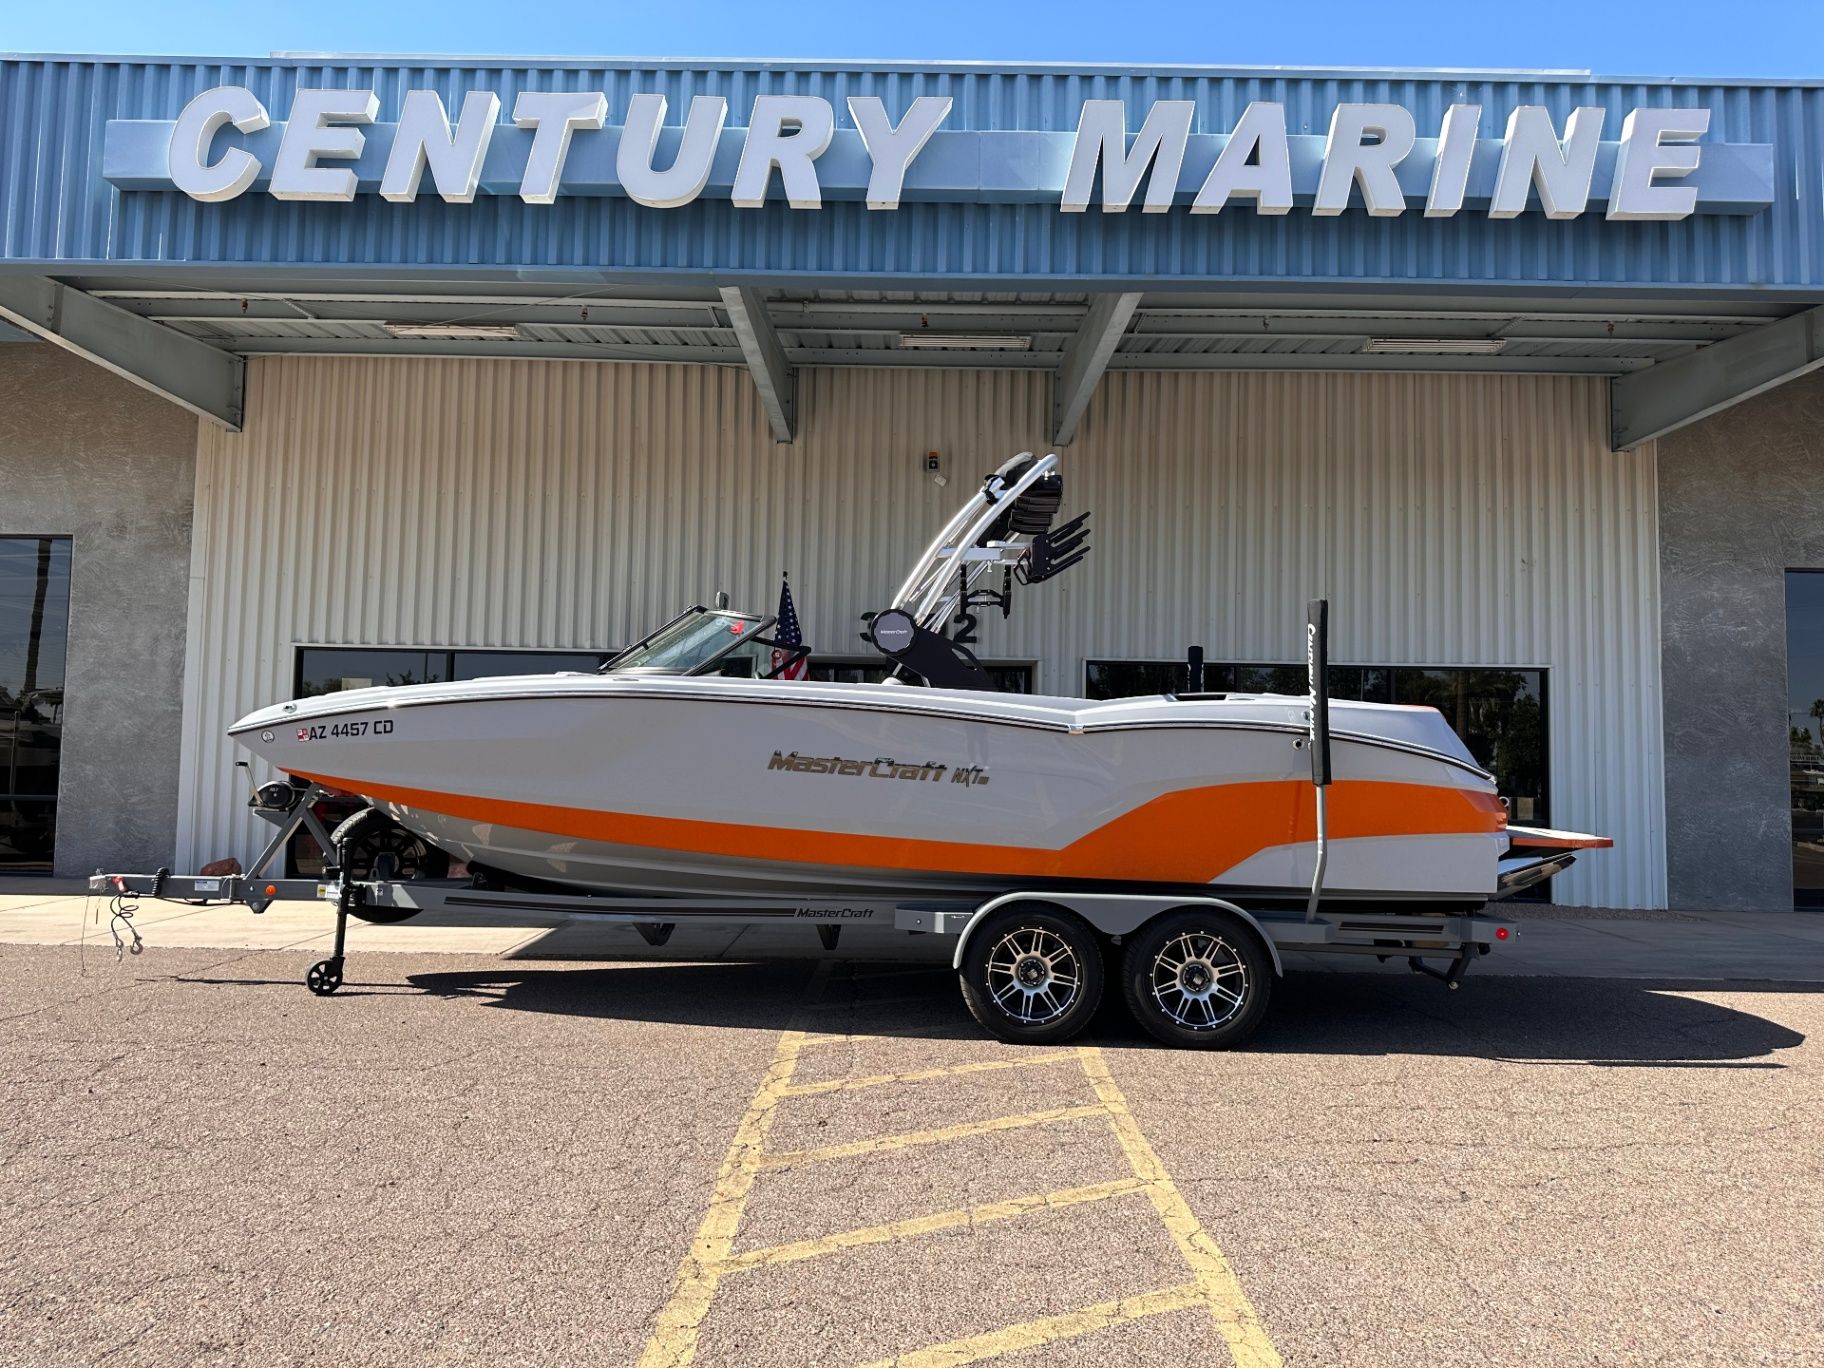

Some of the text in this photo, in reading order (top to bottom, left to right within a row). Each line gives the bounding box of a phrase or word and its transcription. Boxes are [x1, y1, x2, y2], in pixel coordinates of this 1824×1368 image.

[168, 85, 1711, 220] CENTURY MARINE
[309, 720, 394, 741] AZ 4457 CD
[767, 750, 947, 782] MasterCraft
[797, 908, 874, 918] MasterCraft
